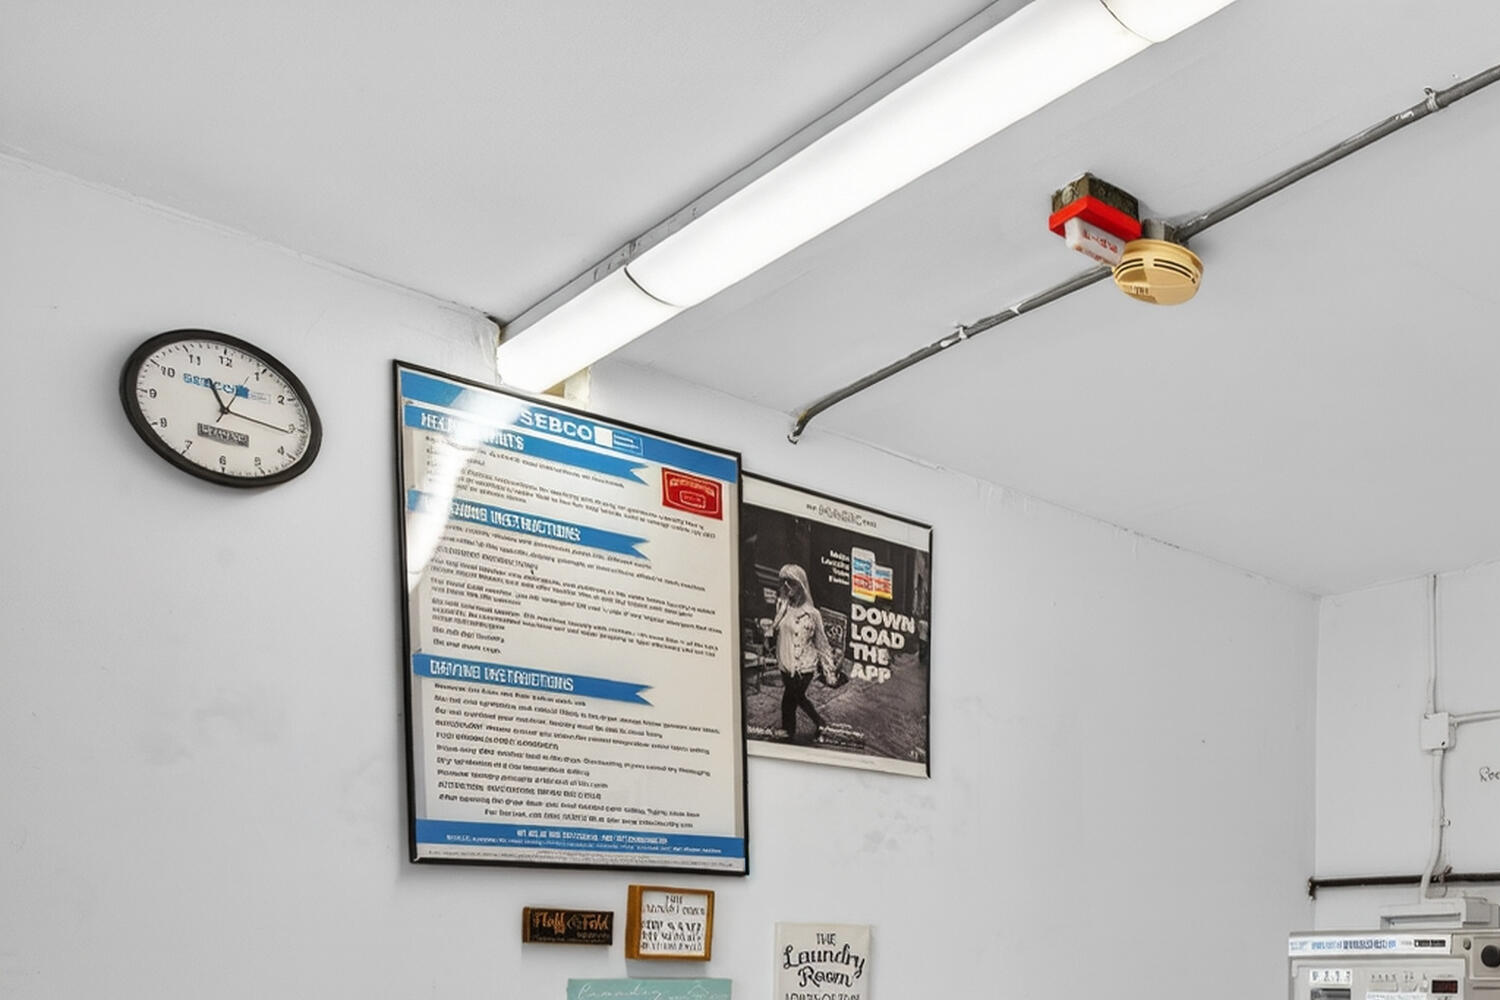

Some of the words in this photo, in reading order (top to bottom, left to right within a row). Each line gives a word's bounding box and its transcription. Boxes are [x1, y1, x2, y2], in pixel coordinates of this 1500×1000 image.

[218, 355, 233, 368] 12
[520, 408, 594, 442] SEBCO
[851, 603, 915, 634] DOWN
[851, 623, 905, 649] LOAD
[849, 641, 889, 666] THE
[850, 662, 891, 683] APP
[816, 933, 836, 946] THE
[783, 943, 866, 979] Laundry
[797, 965, 853, 987] Room
